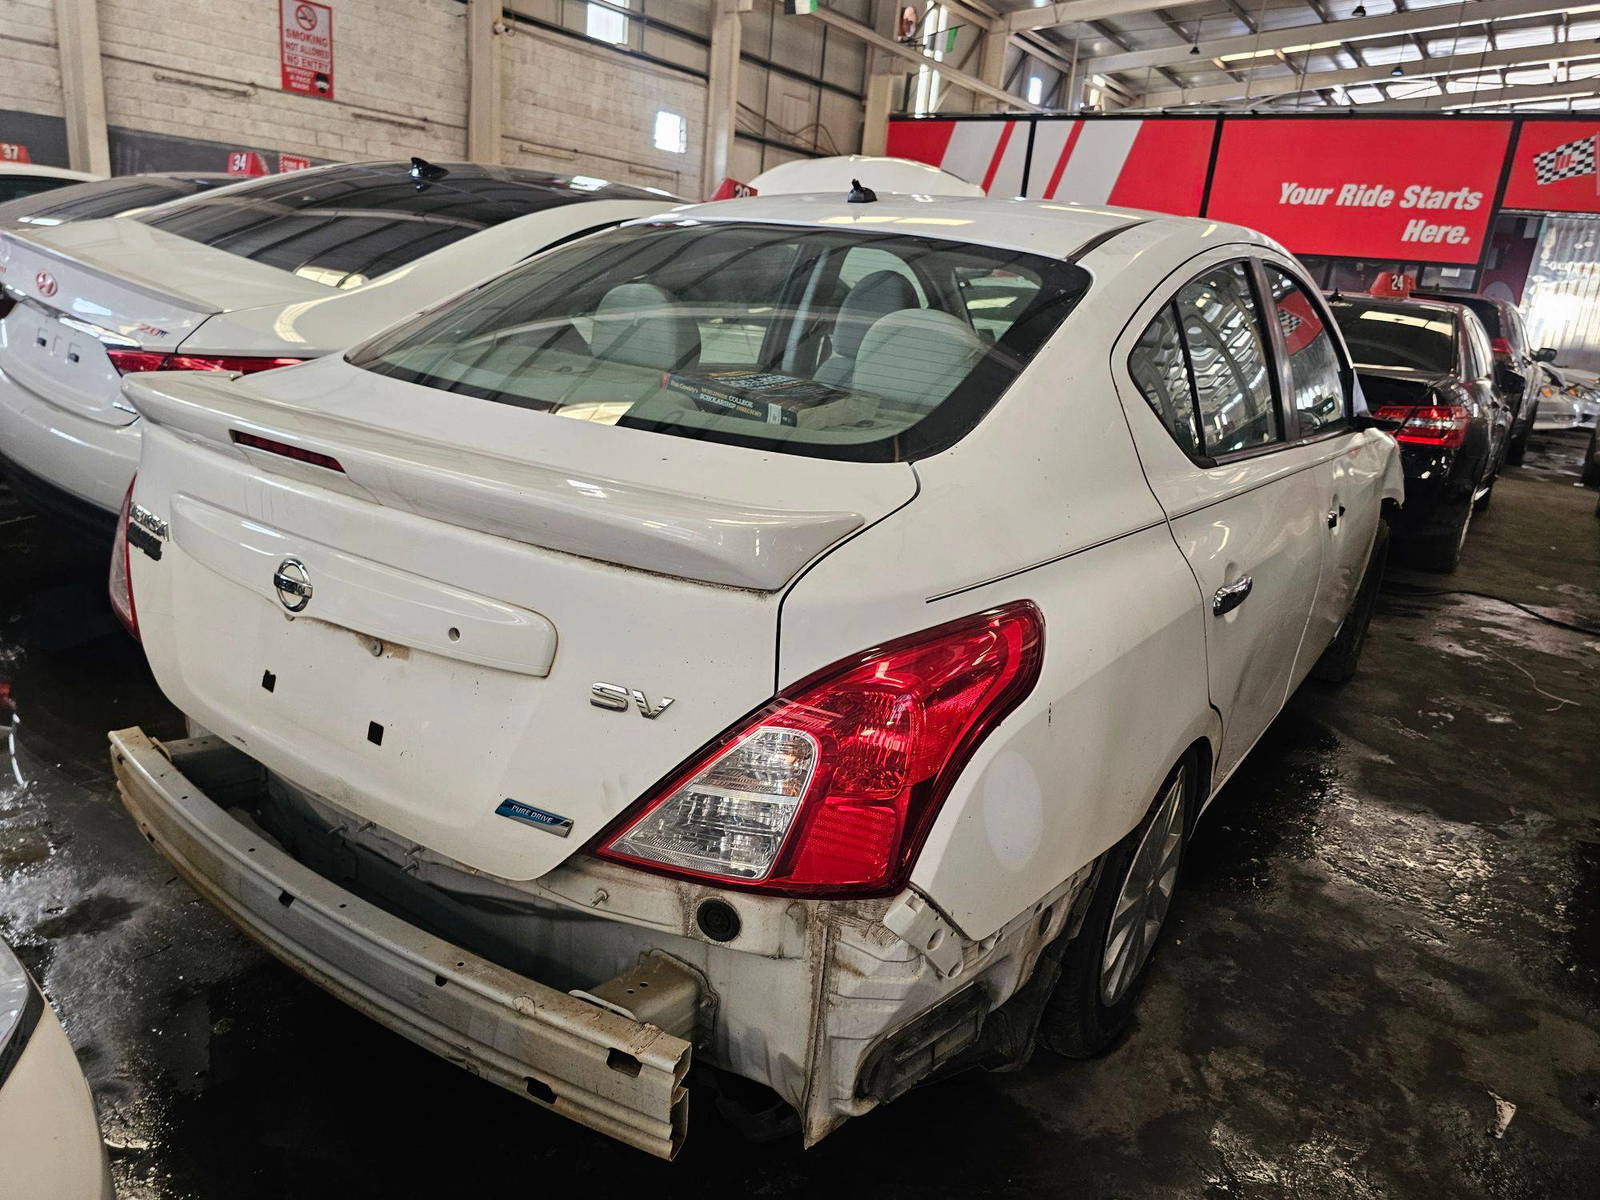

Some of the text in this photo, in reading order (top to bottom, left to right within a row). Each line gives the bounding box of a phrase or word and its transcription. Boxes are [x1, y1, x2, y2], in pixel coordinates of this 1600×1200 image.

[286, 29, 328, 47] SMOKING
[287, 55, 328, 72] NO ENTRY
[3, 144, 18, 159] 37
[232, 154, 247, 171] 34
[1278, 182, 1483, 211] Your Ride Starts
[1401, 219, 1471, 245] Here.
[1391, 274, 1404, 291] 24
[590, 681, 676, 720] SV
[511, 804, 554, 824] PURE DRIVE
